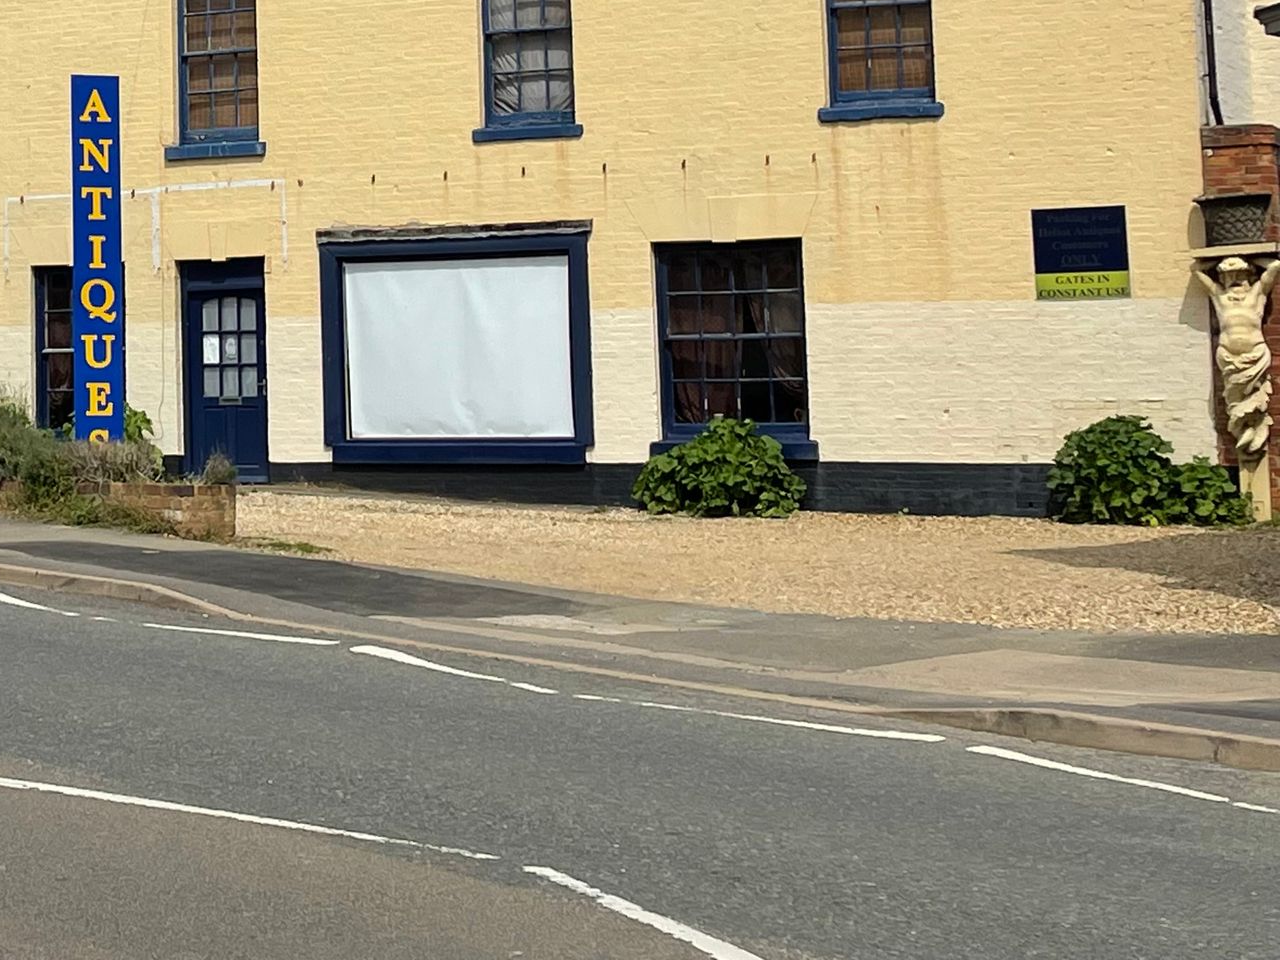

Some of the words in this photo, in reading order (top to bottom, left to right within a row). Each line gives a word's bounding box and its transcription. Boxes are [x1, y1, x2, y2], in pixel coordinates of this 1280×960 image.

[1055, 275, 1095, 285] GATES
[1097, 273, 1110, 283] IN
[1039, 287, 1103, 298] CONSTANT
[1105, 286, 1128, 296] USE
